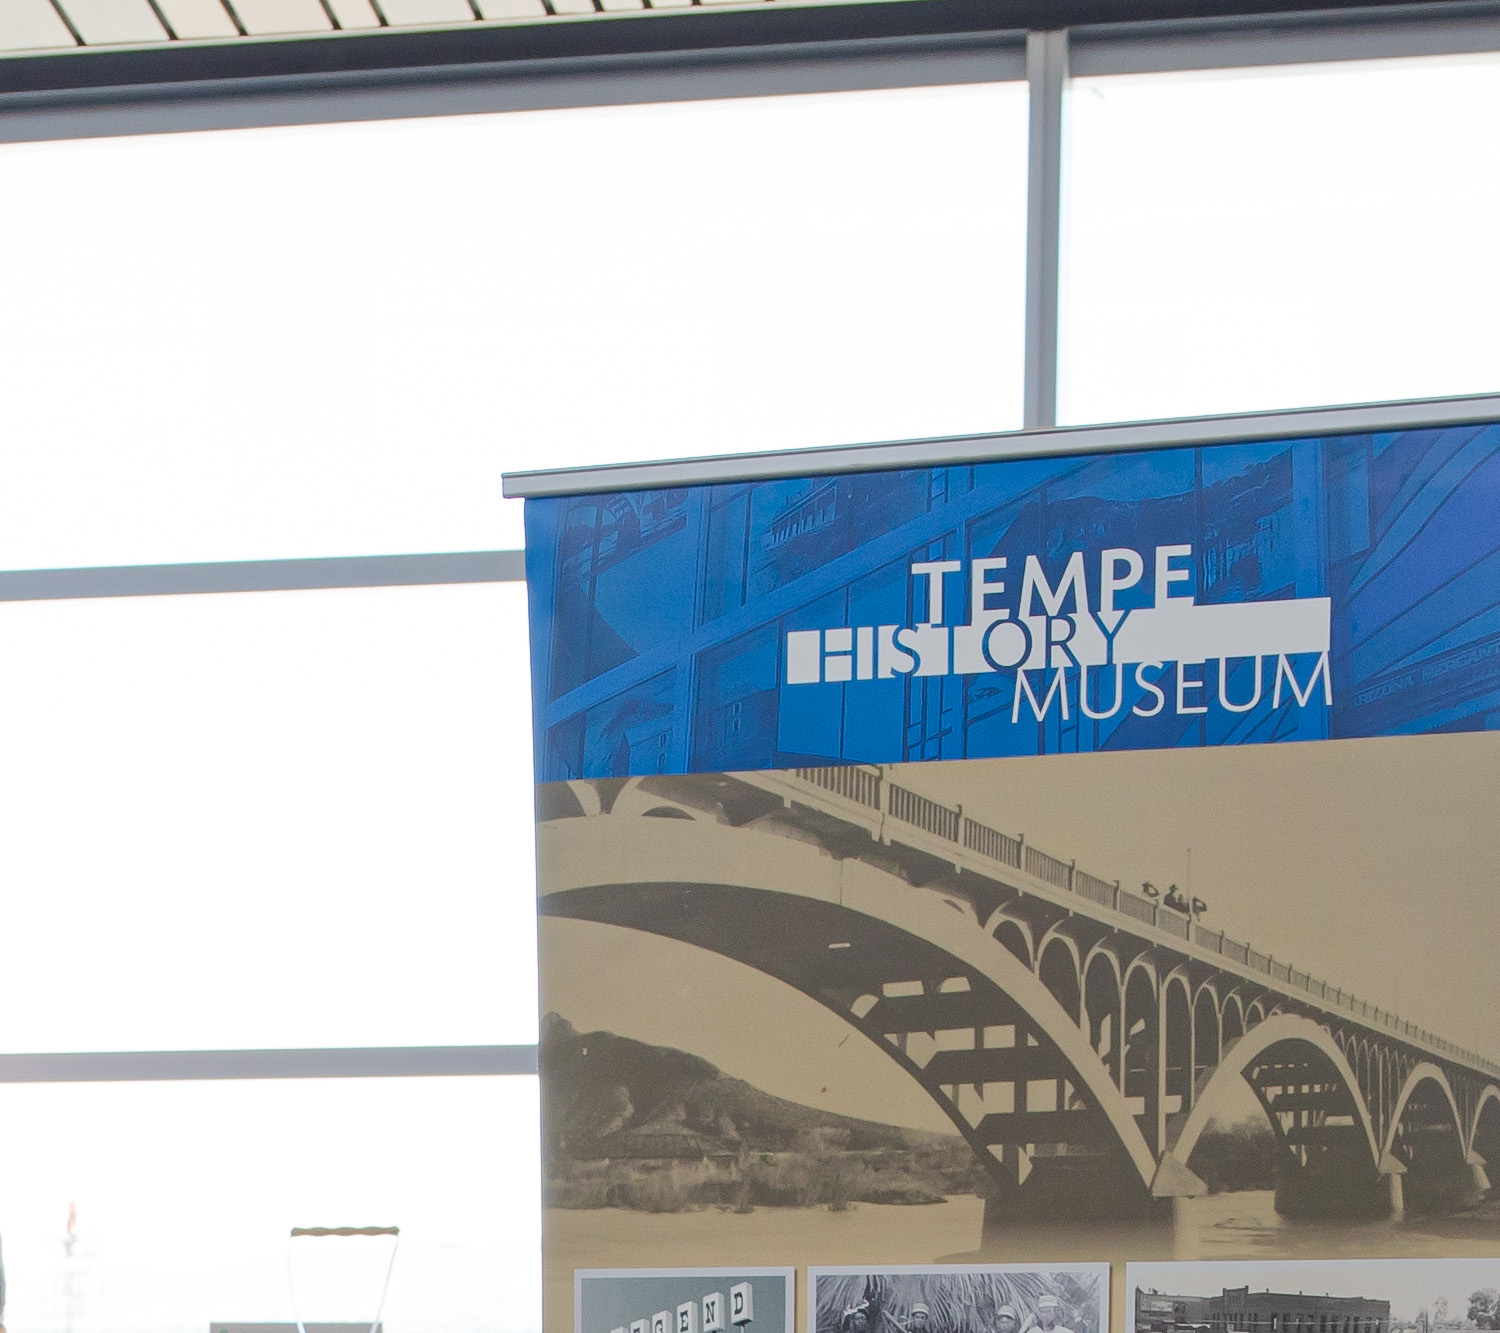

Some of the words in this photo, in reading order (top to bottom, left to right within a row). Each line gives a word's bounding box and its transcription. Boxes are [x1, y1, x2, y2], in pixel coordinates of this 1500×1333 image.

[911, 543, 1194, 627] TEMPE
[819, 608, 1133, 683] HISTORY
[1011, 650, 1333, 724] MUSEUM
